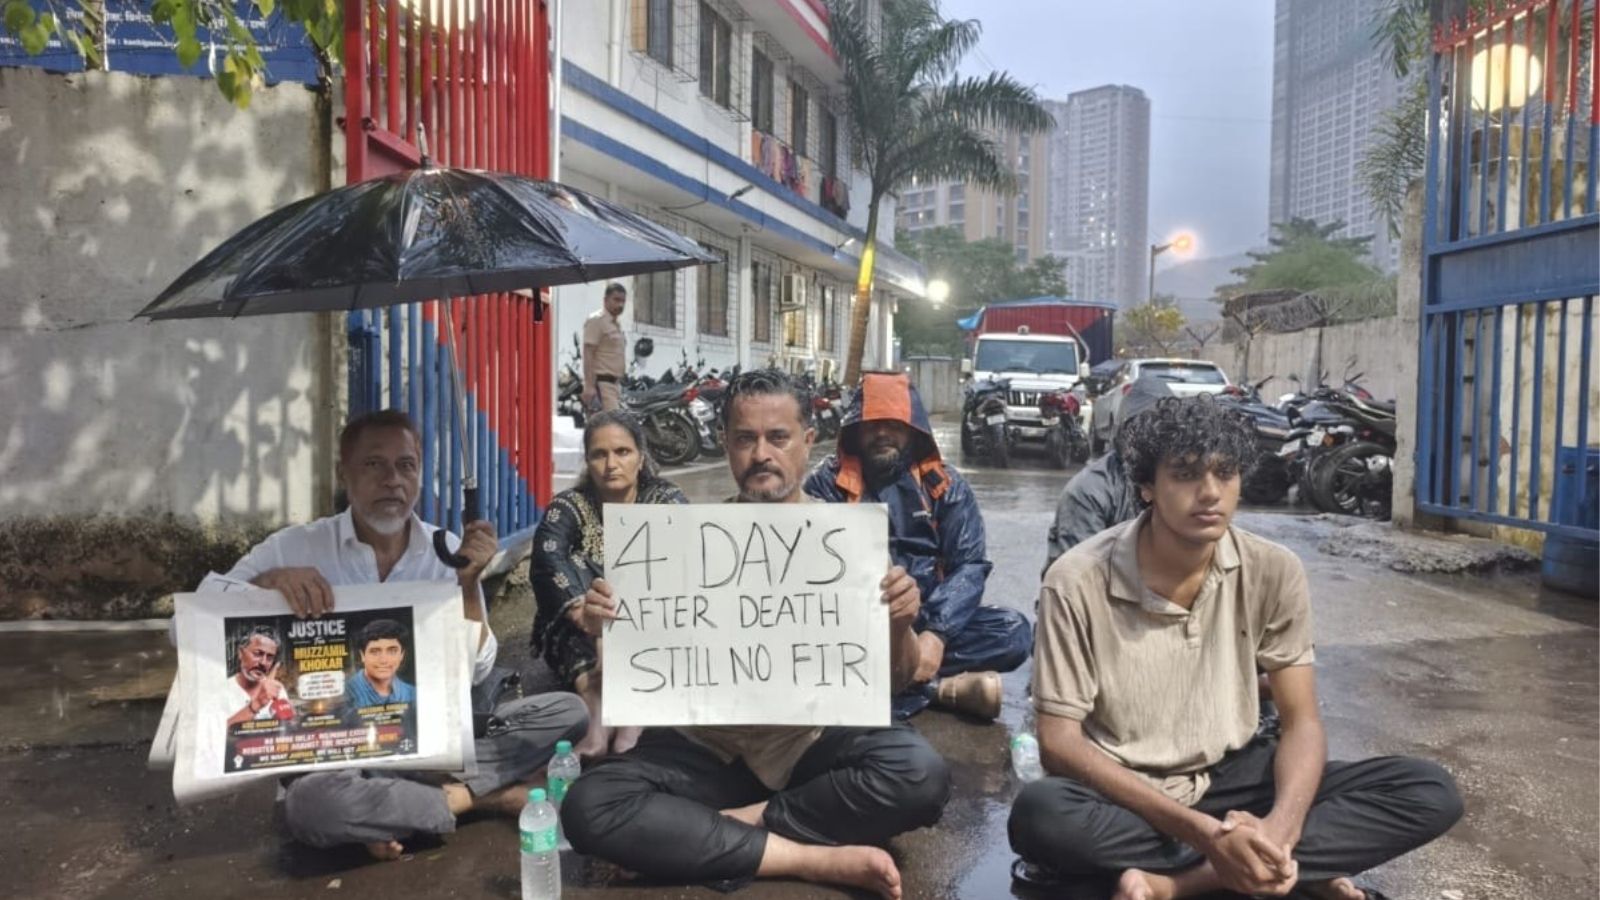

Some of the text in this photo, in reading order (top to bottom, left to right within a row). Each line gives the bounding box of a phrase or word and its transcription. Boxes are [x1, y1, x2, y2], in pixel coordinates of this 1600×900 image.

[699, 519, 846, 589] DAY'S
[607, 592, 840, 632] AFTER DEATH
[288, 620, 346, 638] JUSTICE
[294, 643, 349, 660] MUZZAMIL
[299, 657, 344, 672] KHOKAR
[630, 642, 869, 692] STILL NO FIR
